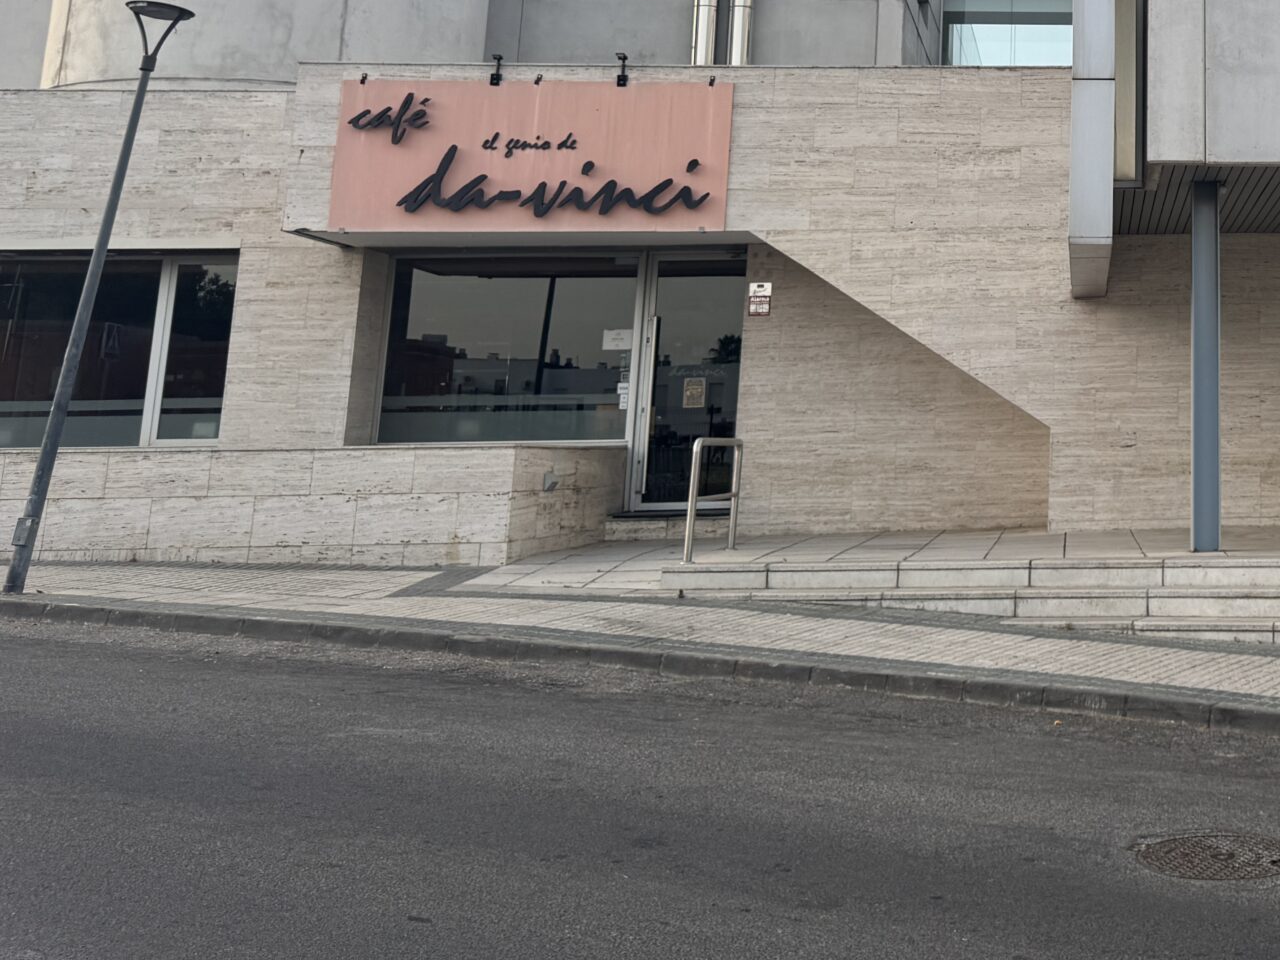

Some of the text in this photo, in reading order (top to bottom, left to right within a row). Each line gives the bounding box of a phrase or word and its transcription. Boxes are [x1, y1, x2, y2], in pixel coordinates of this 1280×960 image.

[348, 92, 432, 145] café
[482, 132, 578, 158] el genio de
[396, 144, 711, 218] da-vinci
